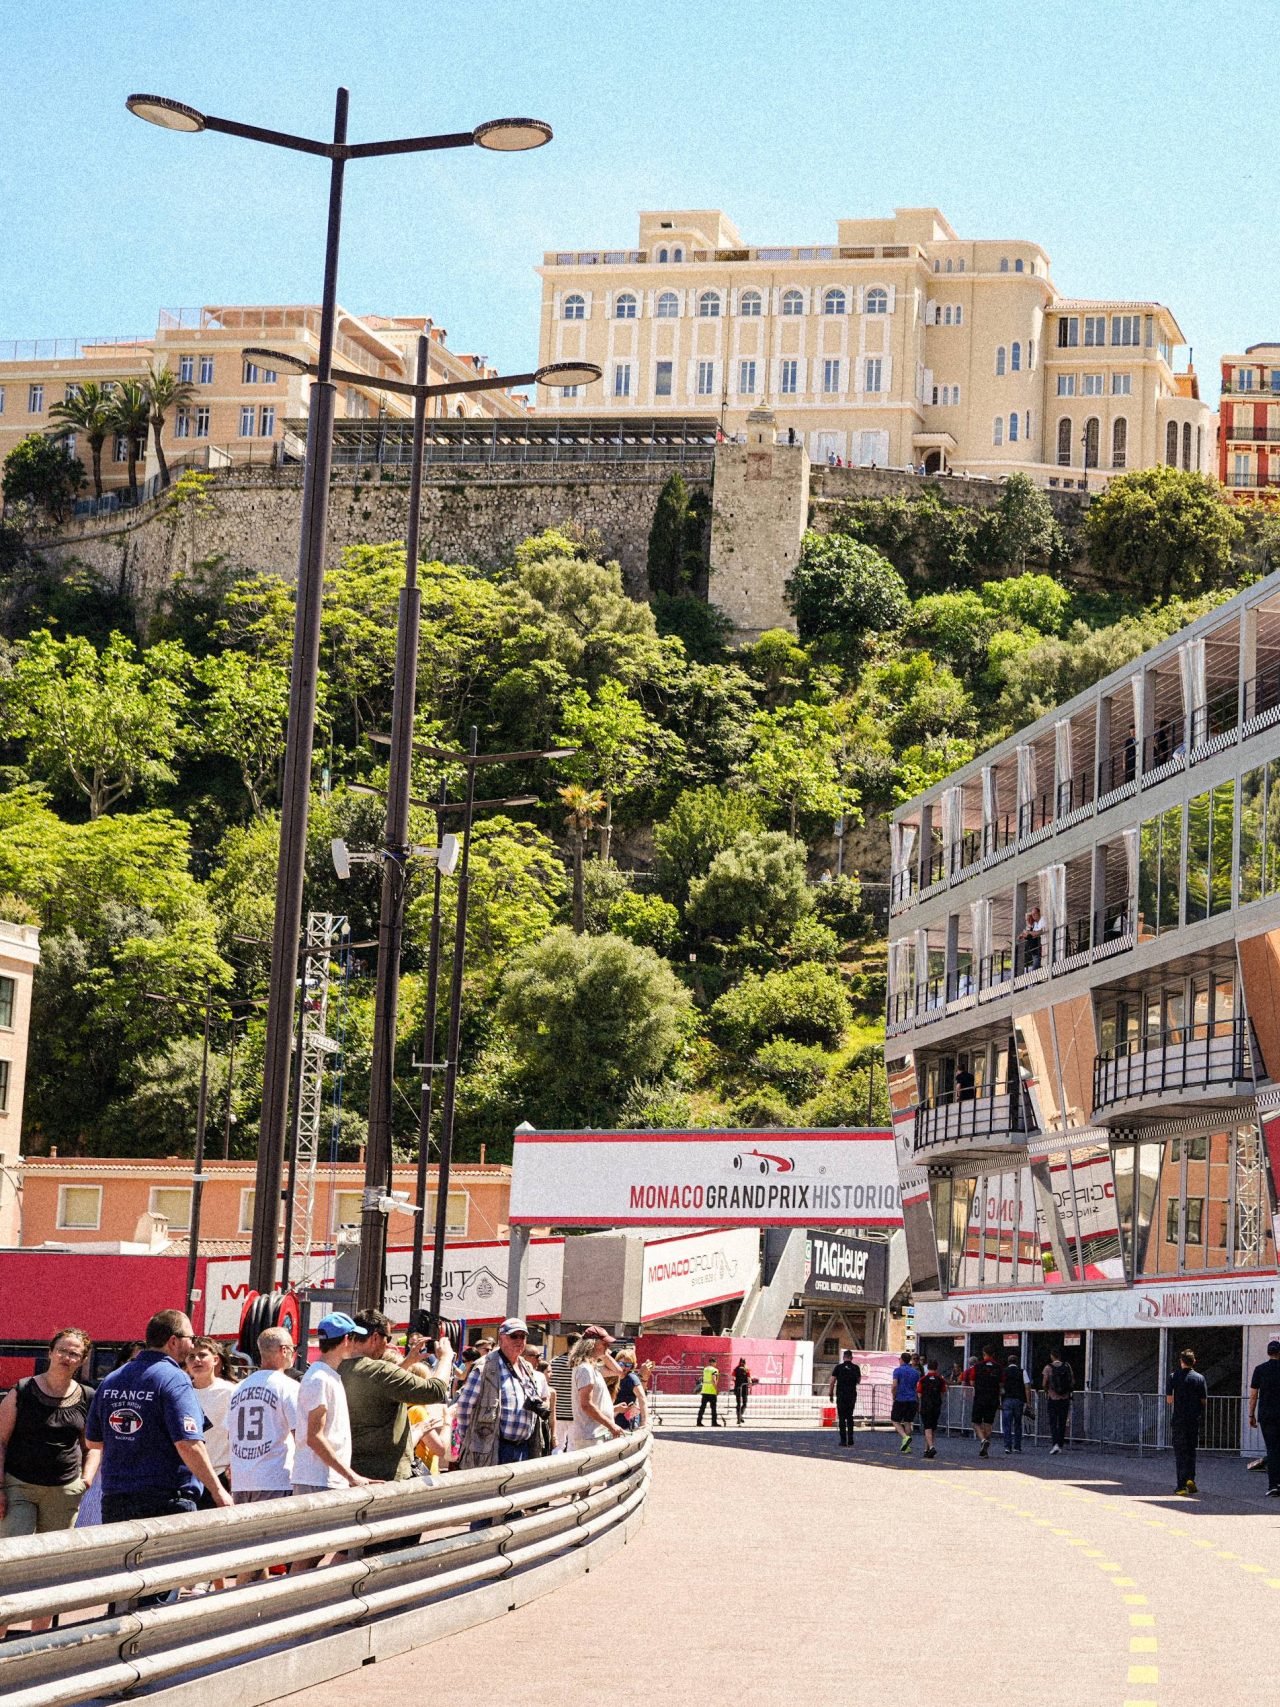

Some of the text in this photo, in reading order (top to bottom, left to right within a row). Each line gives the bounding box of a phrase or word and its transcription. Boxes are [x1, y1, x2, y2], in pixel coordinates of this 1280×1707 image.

[103, 1389, 155, 1401] FRANCE
[230, 1386, 278, 1411] SICKSIDE
[237, 1406, 264, 1441] 13
[232, 1440, 272, 1460] MACHINE
